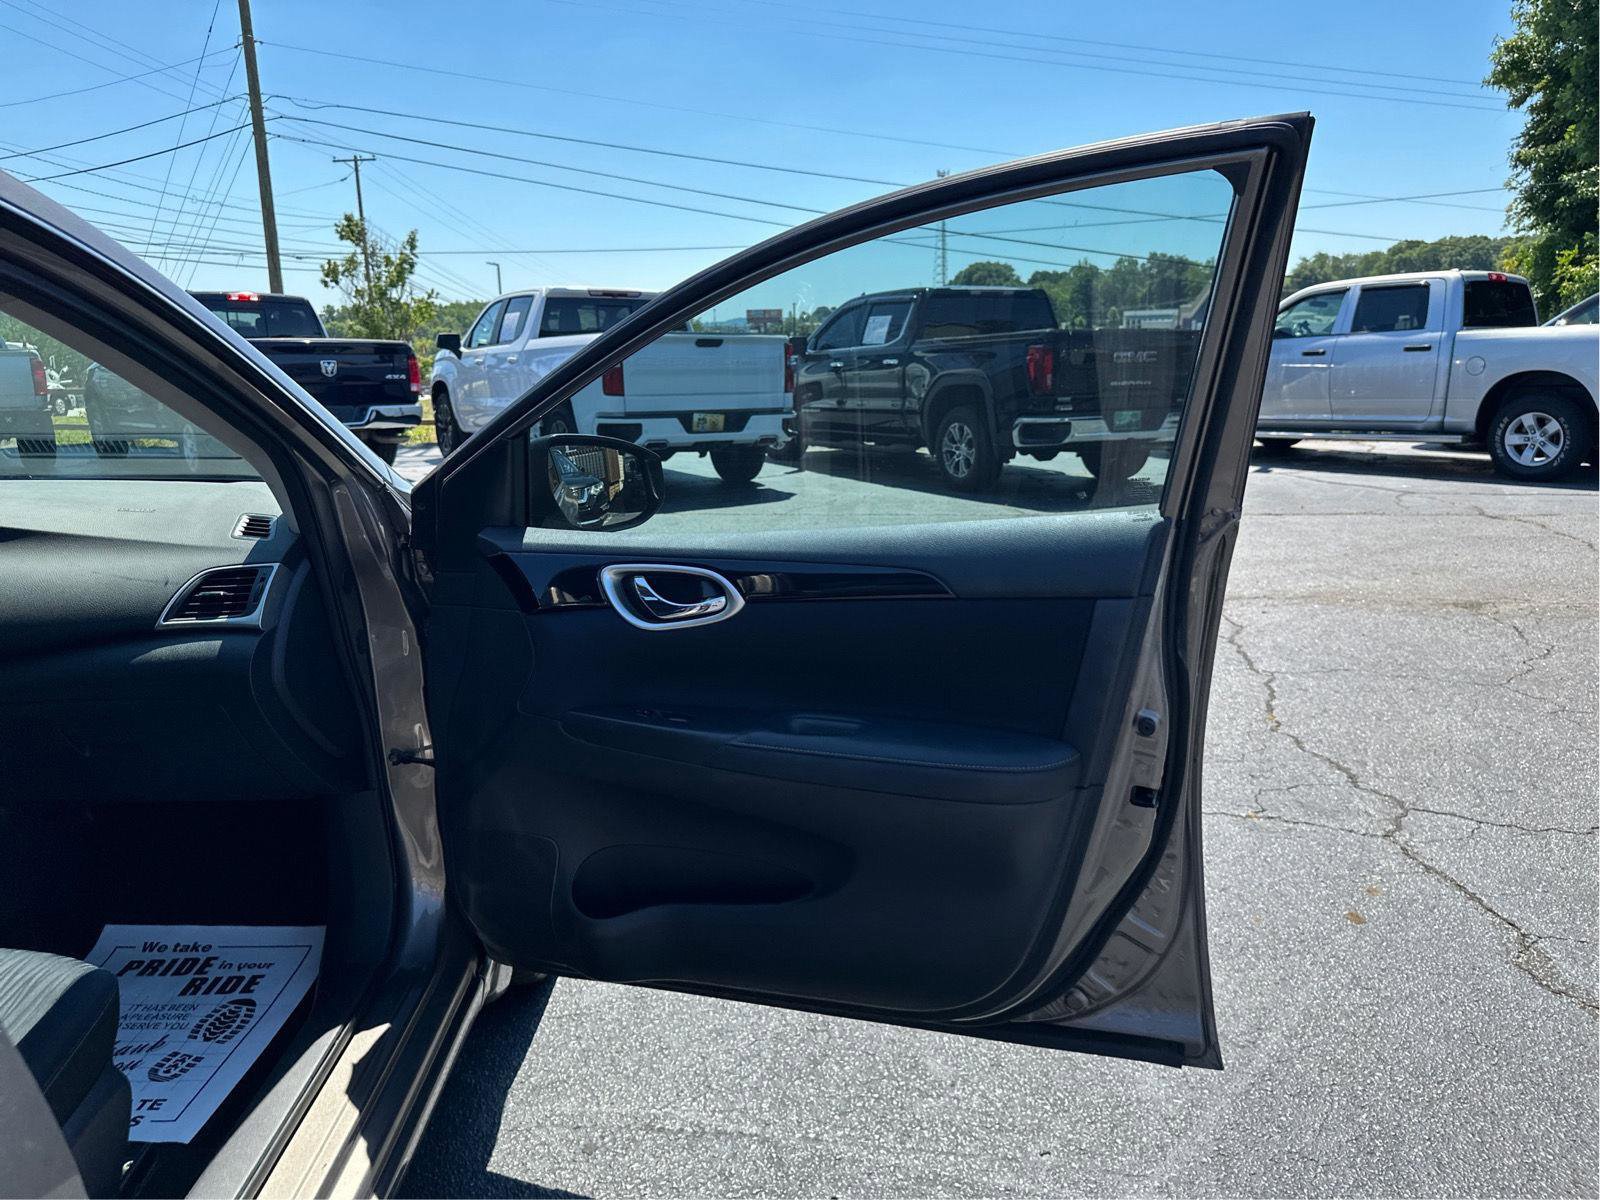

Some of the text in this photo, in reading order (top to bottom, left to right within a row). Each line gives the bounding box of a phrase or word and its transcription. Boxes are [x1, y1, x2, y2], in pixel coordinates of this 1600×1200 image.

[1113, 351, 1158, 363] GMC
[142, 941, 213, 953] We take
[116, 956, 275, 977] PRIDE in your
[178, 974, 266, 997] RIDE
[141, 1004, 168, 1012] HAS
[167, 1004, 199, 1012] BEEN
[130, 1012, 190, 1021] PLEASURE
[164, 1022, 190, 1030] YOU
